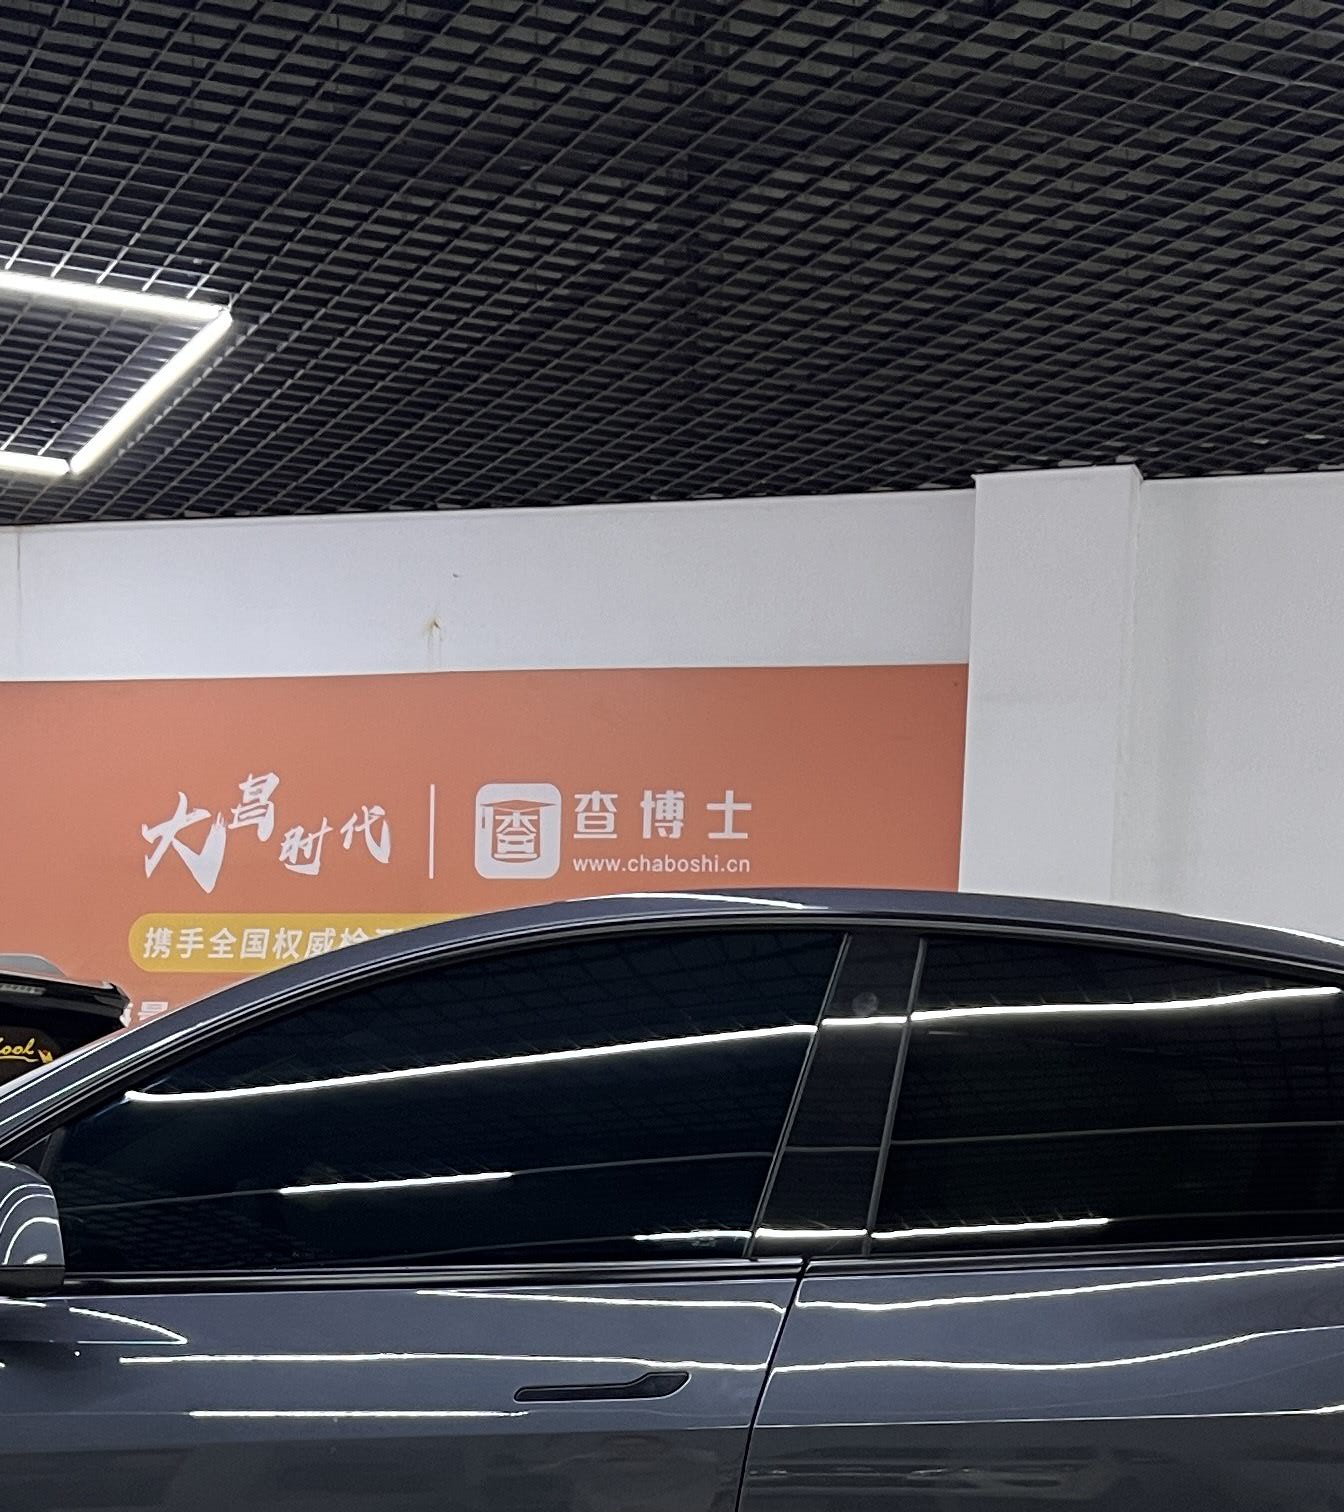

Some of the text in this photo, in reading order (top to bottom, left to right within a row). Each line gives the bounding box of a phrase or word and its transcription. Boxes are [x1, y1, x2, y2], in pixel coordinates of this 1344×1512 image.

[573, 790, 752, 839] 查博士
[573, 854, 751, 873] www.chaboshi.cn
